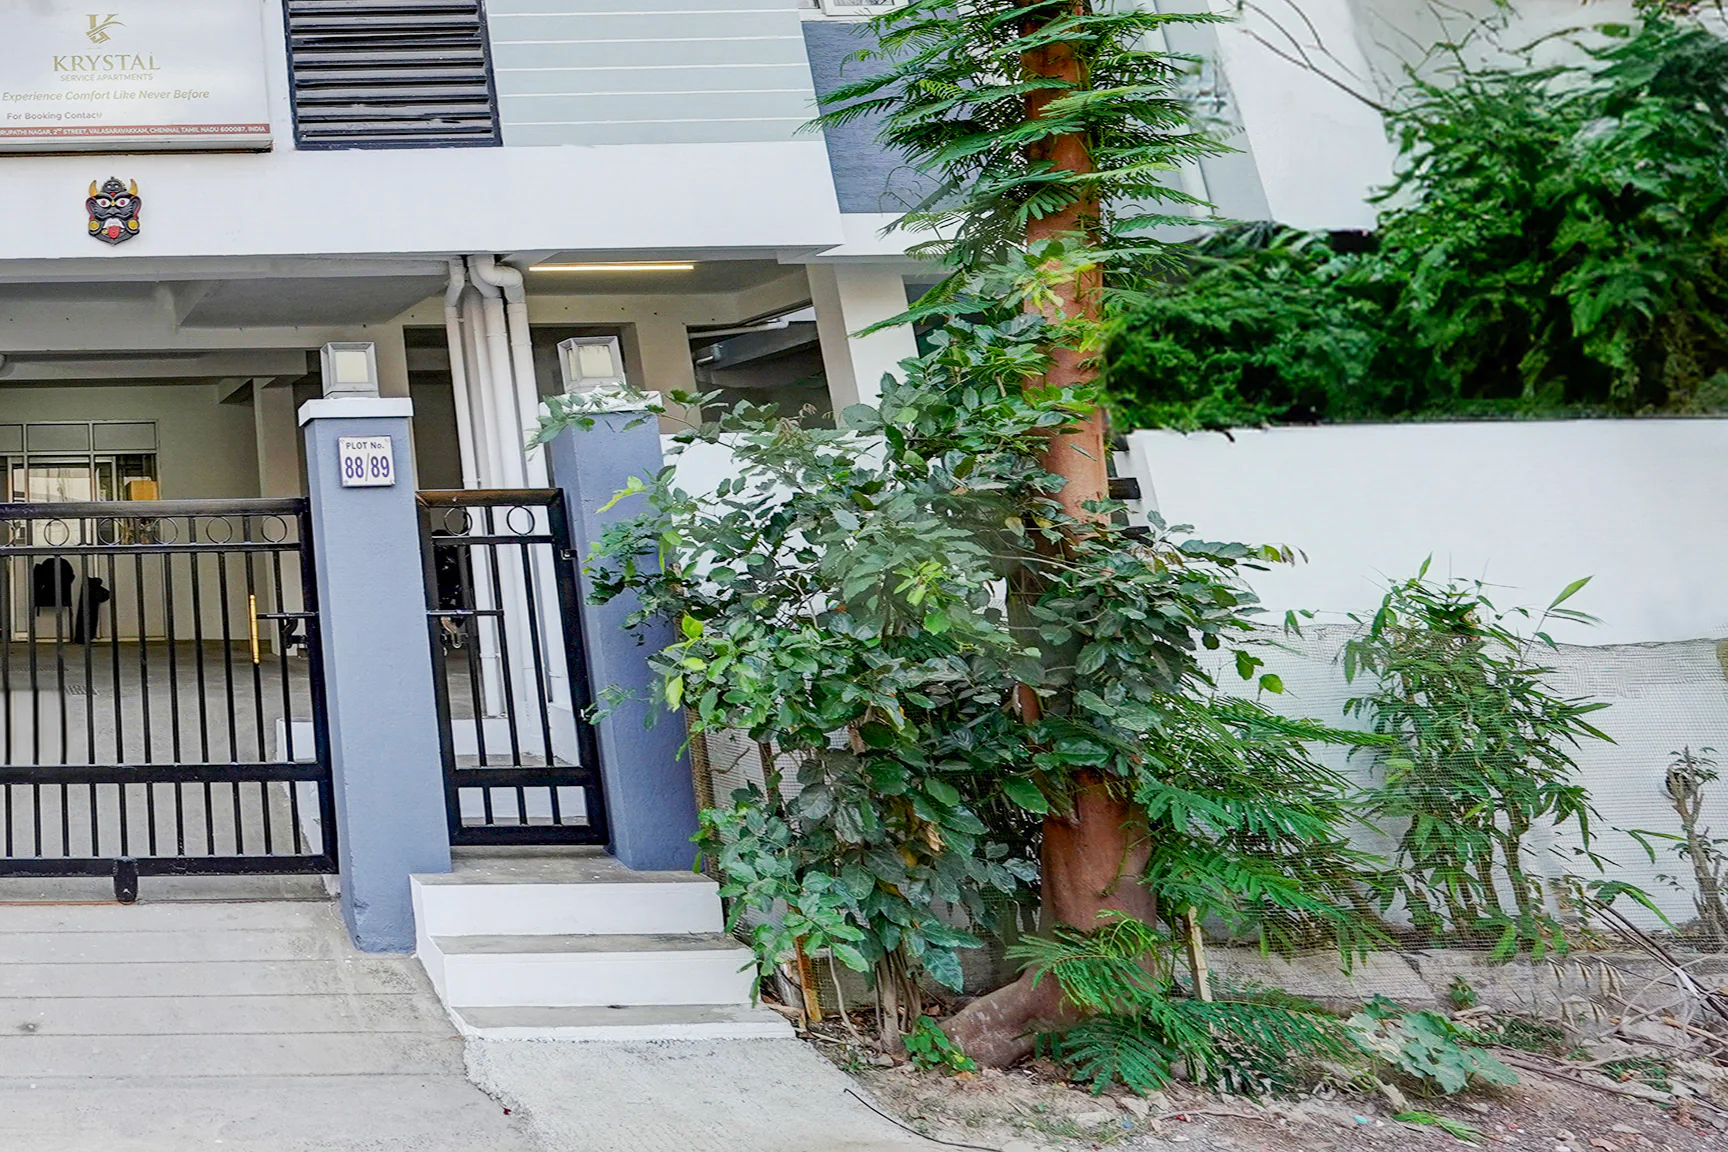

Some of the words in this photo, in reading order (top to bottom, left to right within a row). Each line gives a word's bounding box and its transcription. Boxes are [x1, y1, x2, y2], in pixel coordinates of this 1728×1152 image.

[52, 53, 161, 72] KRYSTAL
[60, 74, 94, 82] SERVICE
[96, 73, 153, 81] APARTMENTS
[2, 92, 63, 103] Experience
[65, 90, 111, 102] Comfort
[113, 90, 136, 100] Like
[138, 90, 171, 99] Never
[173, 89, 210, 101] Before
[6, 112, 22, 120] For
[24, 112, 62, 121] Booking
[345, 441, 368, 450] PLOT
[370, 441, 385, 449] No.
[344, 453, 390, 482] 88/89
